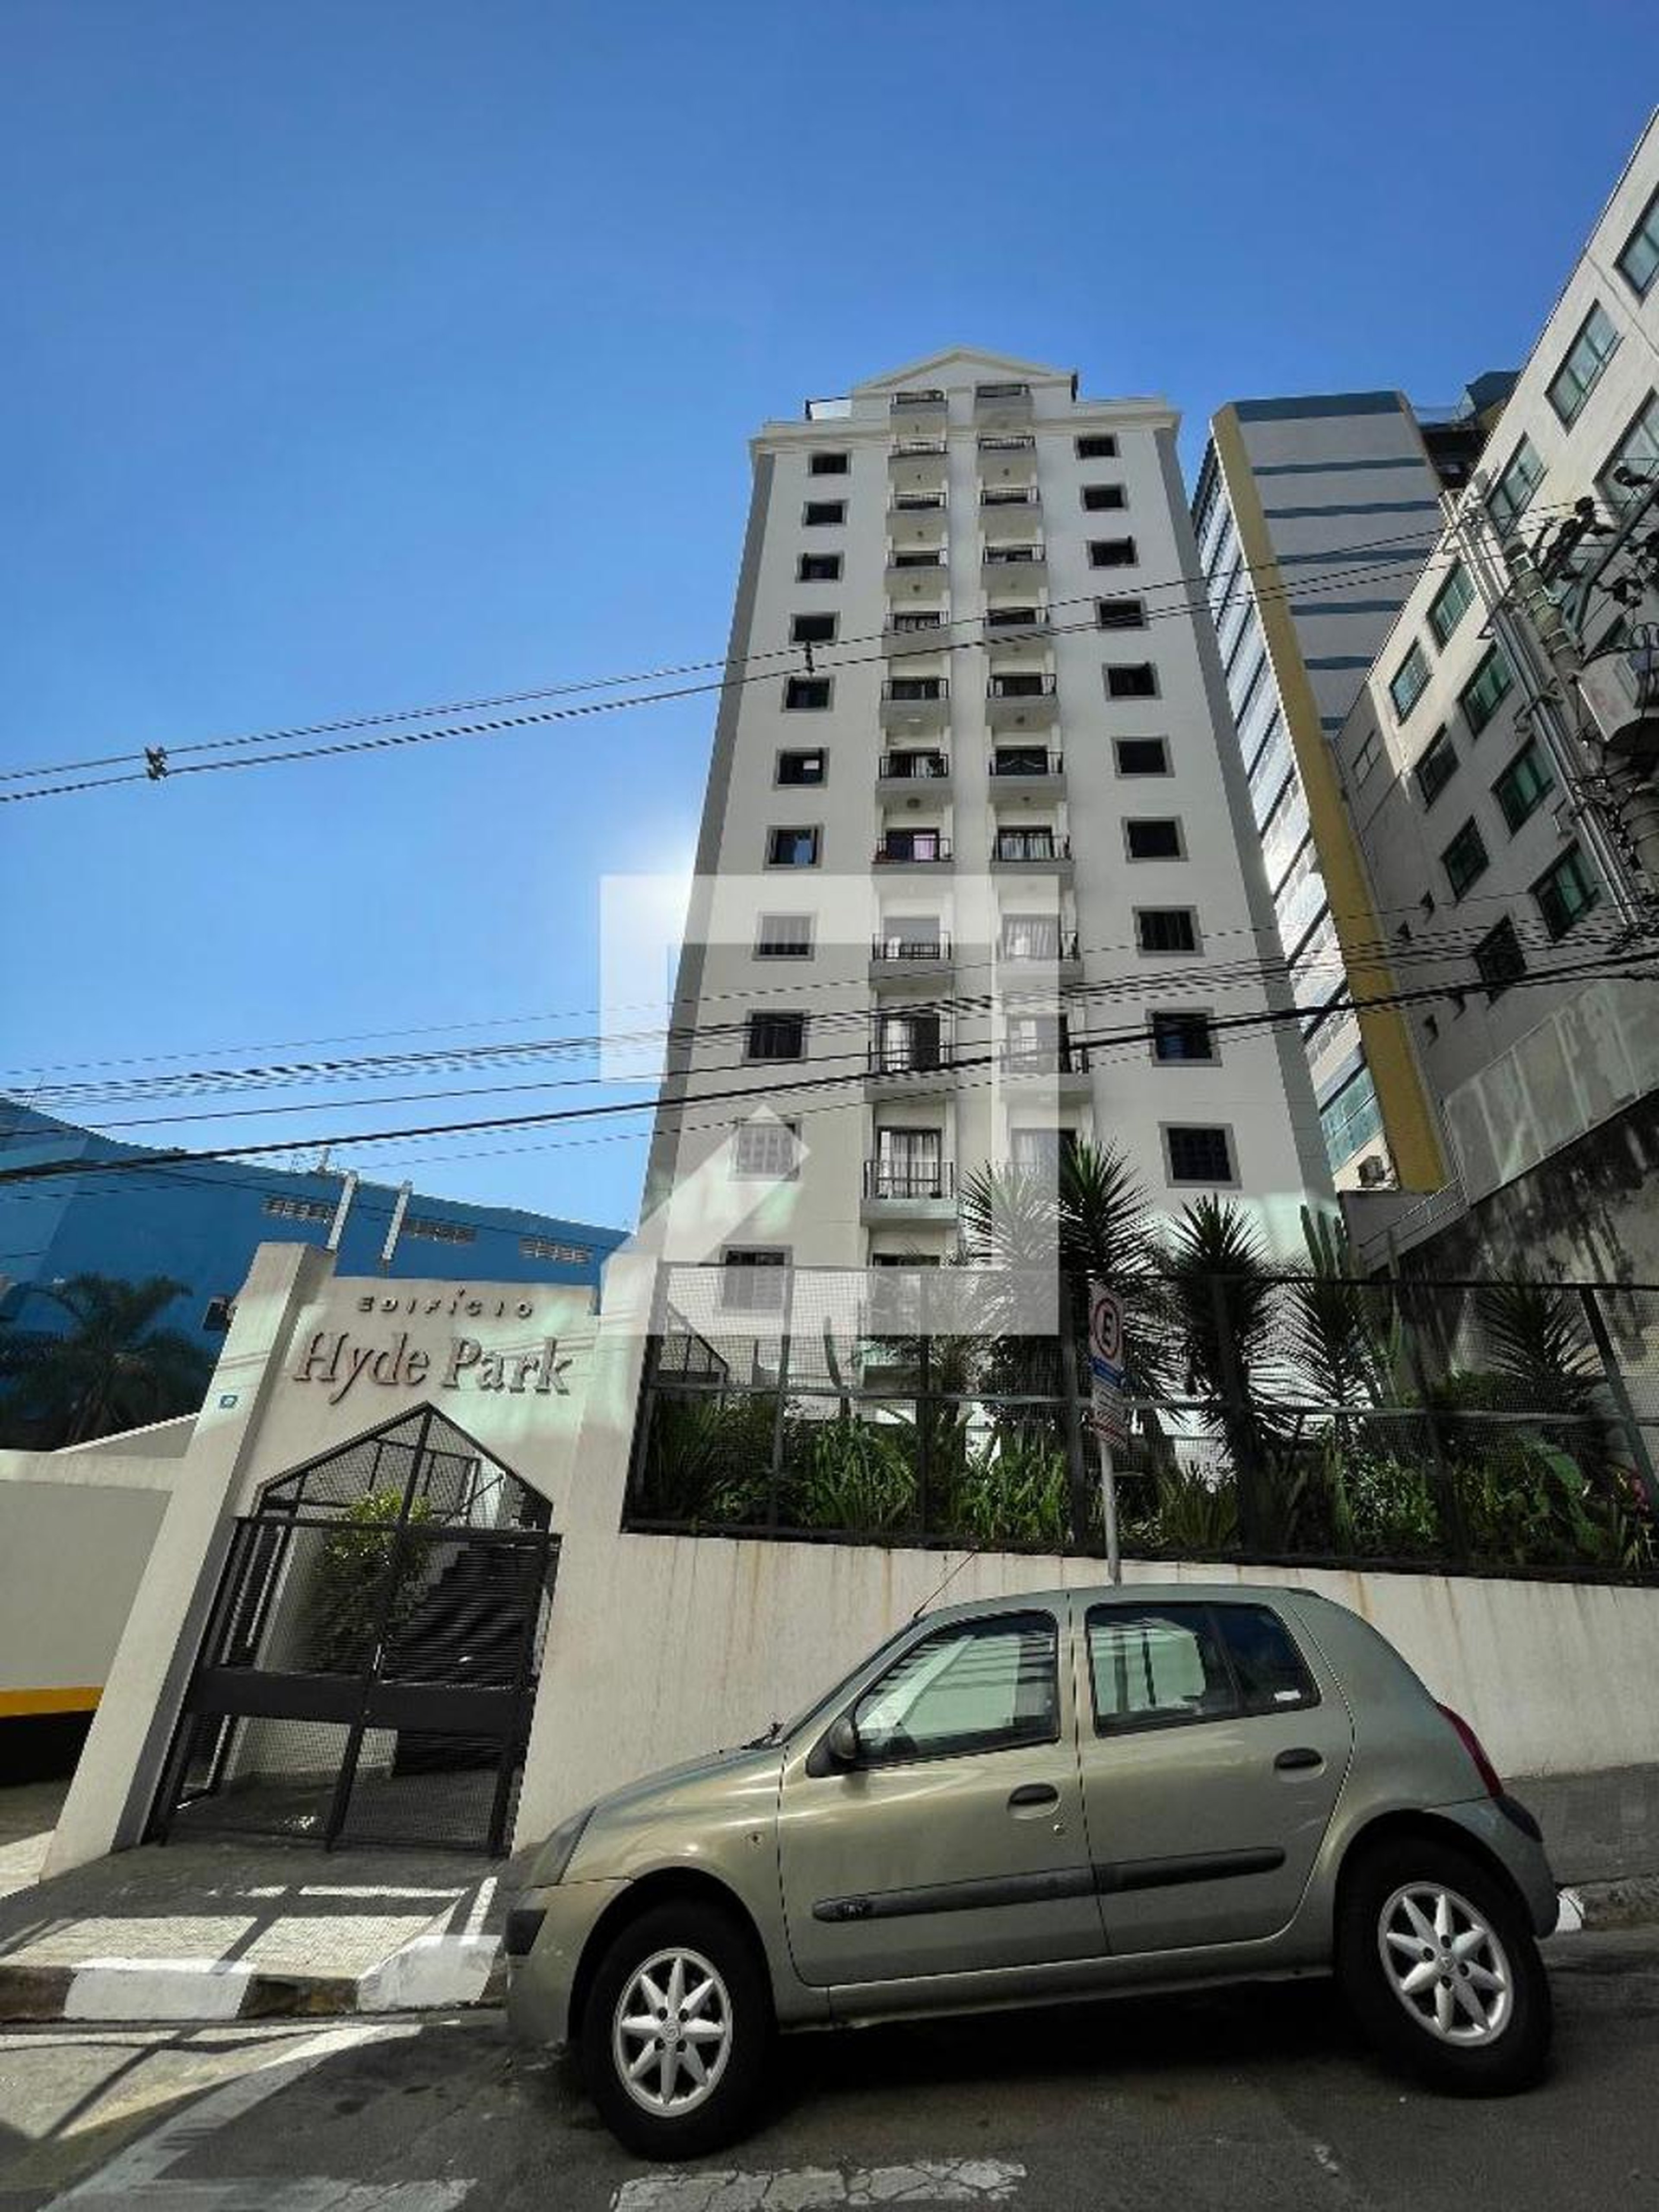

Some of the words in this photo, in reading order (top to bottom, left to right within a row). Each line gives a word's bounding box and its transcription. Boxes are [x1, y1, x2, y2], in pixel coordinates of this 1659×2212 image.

[358, 1286, 533, 1318] EDIFÍCIO
[1102, 1311, 1113, 1348] E
[292, 1331, 430, 1406] Hyde
[441, 1337, 573, 1395] Park
